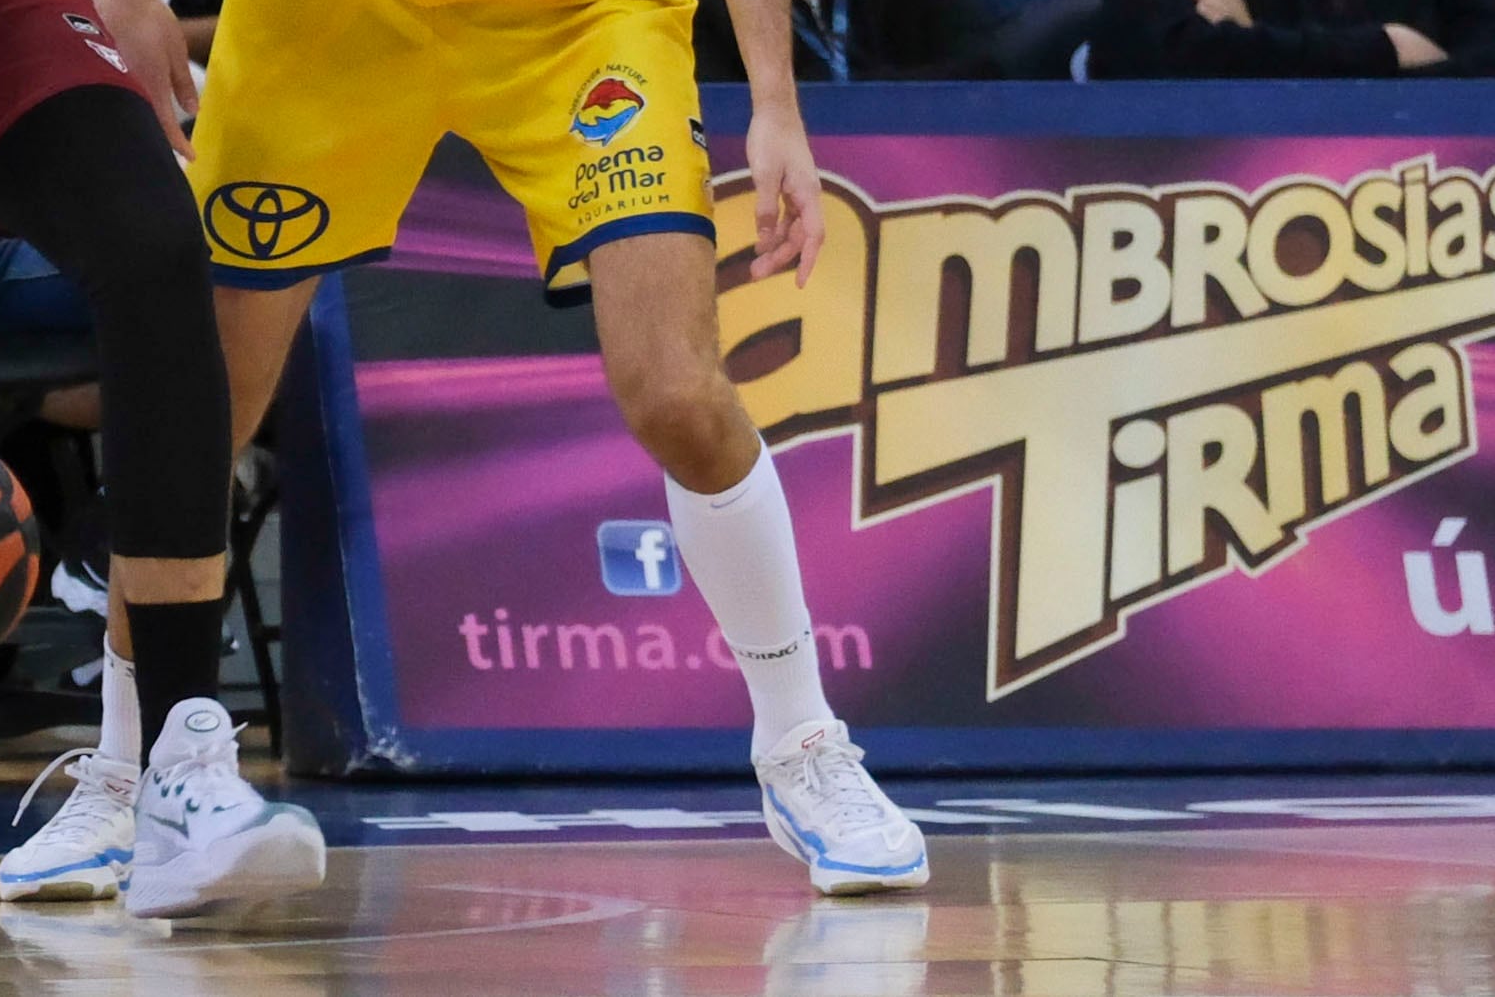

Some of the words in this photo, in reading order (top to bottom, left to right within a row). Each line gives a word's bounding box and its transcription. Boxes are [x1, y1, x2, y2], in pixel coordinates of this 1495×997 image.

[605, 63, 649, 87] NATURE
[568, 181, 600, 210] del
[577, 193, 671, 226] AQUARIUM
[458, 607, 873, 671] tirma.cm
